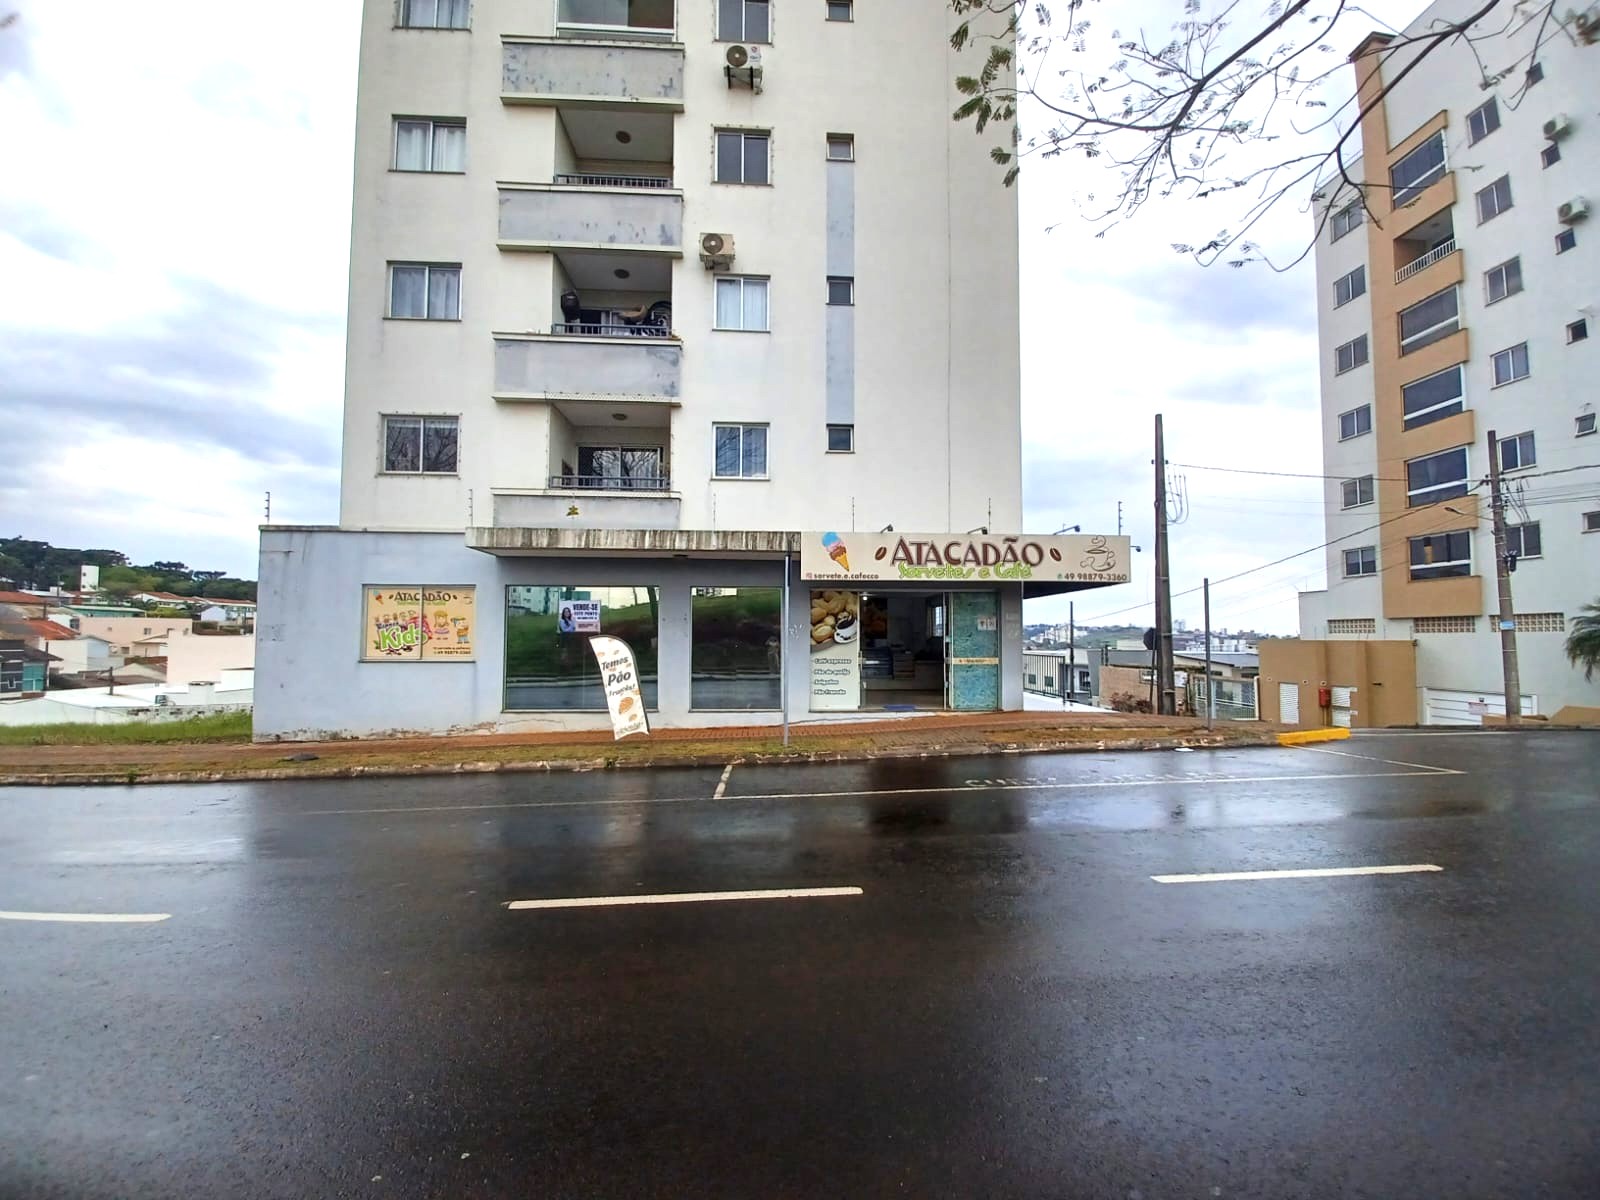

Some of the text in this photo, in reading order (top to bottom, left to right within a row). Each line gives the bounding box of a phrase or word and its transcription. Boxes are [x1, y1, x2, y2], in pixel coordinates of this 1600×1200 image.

[891, 536, 1044, 567] ATACADÃO
[898, 561, 1032, 579] Sorvetes e Café
[573, 603, 598, 611] VENDE-SE
[380, 623, 428, 652] Kids
[601, 657, 629, 671] Temos
[608, 671, 632, 686] Pão
